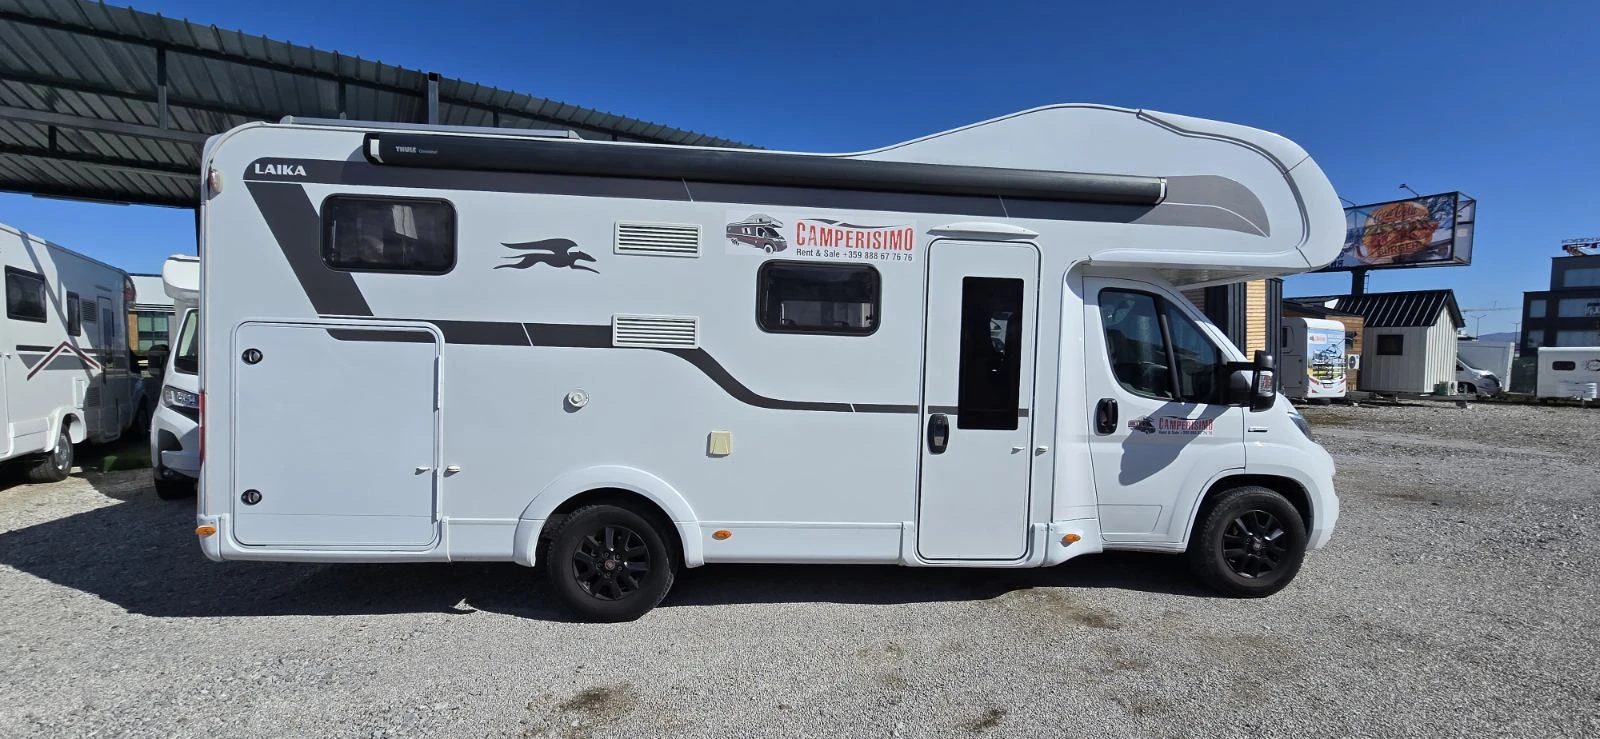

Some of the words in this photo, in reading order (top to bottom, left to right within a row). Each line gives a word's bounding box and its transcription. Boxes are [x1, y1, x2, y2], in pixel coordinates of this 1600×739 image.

[395, 145, 417, 154] THULE
[254, 163, 307, 177] LAIKA
[796, 221, 914, 251] CAMPERISIMO
[1378, 240, 1420, 255] BURGER
[796, 248, 814, 257] Rent
[823, 250, 840, 258] Sale
[842, 250, 862, 259] +359
[864, 251, 878, 260] 888
[880, 252, 889, 260] 67
[892, 252, 901, 261] 76
[903, 253, 913, 262] 76
